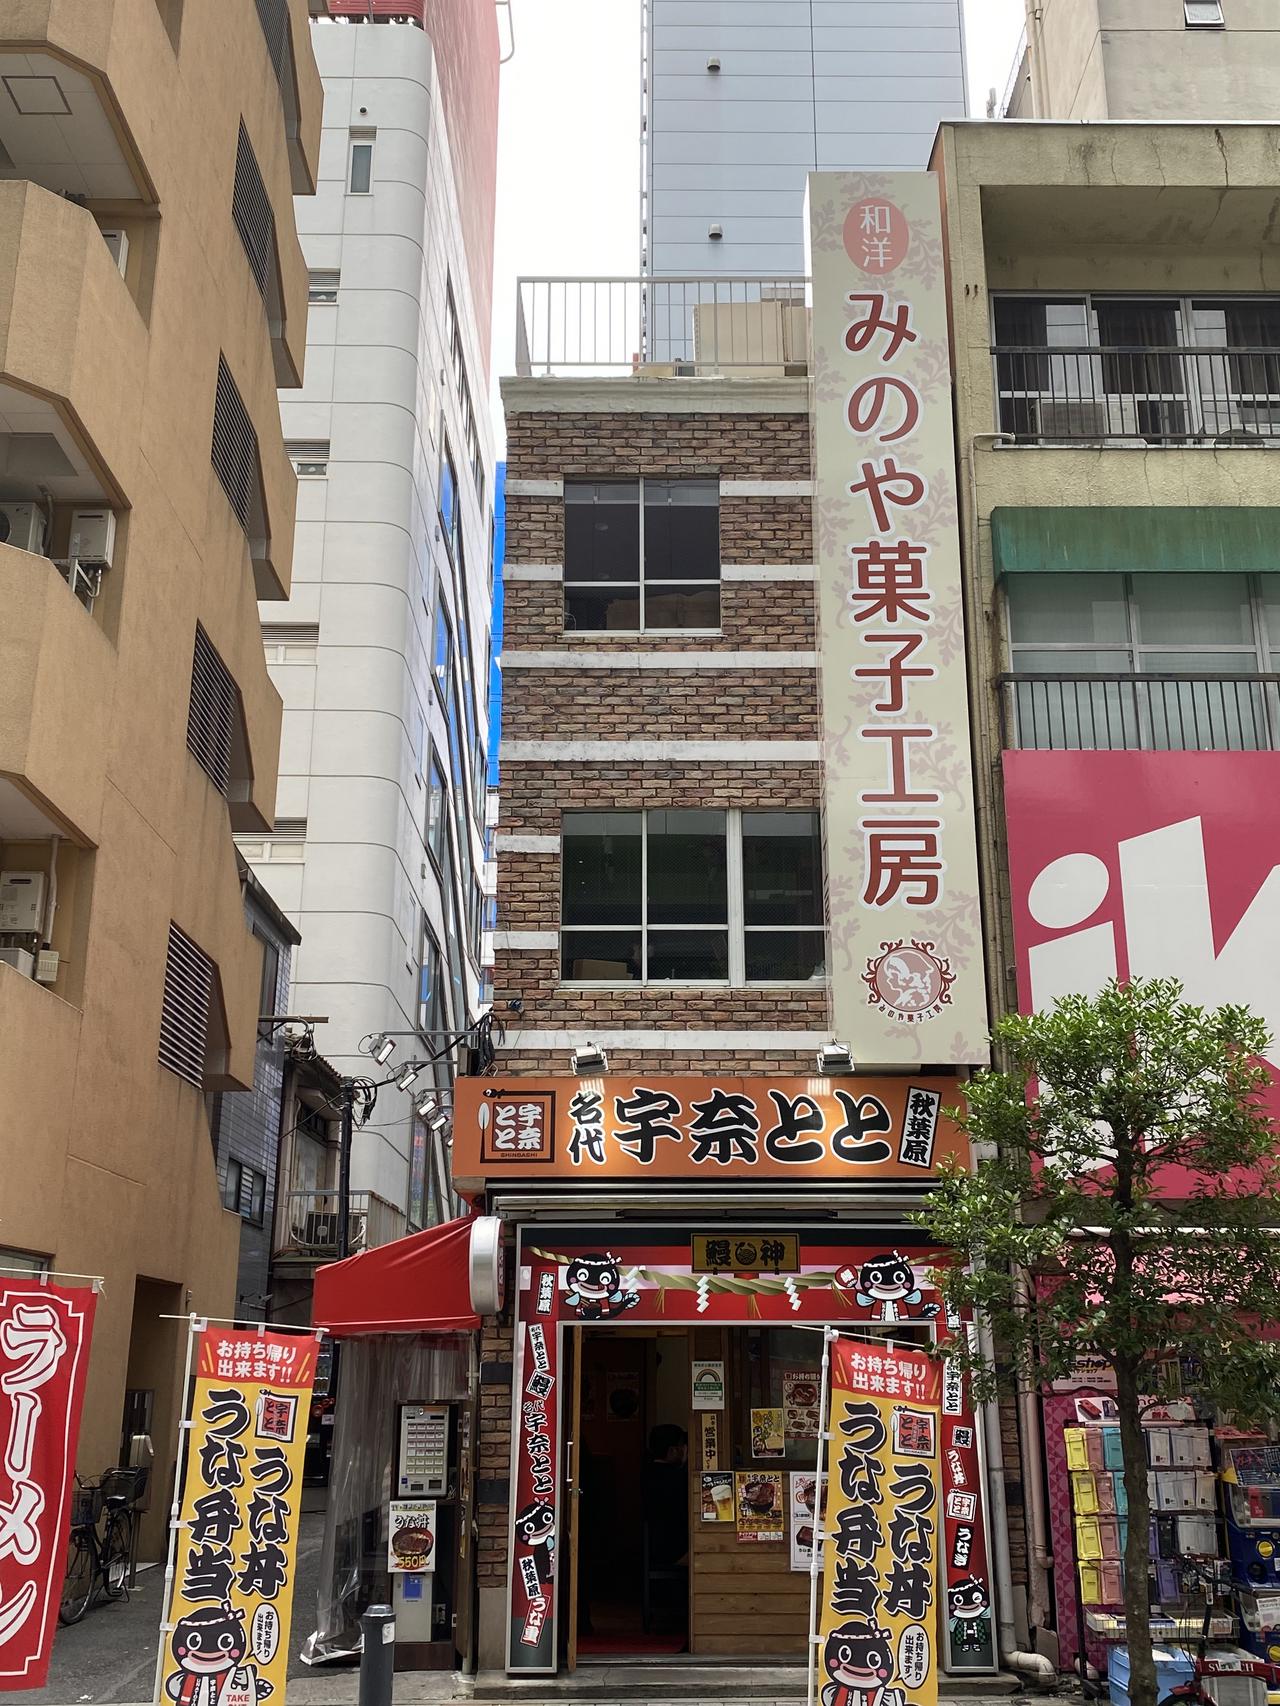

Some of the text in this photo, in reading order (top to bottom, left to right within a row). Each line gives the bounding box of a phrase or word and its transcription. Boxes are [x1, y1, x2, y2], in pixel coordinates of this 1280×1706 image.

[859, 203, 894, 268] 和洋
[843, 290, 945, 908] みのや菓子工房
[567, 1089, 607, 1166] 名代
[613, 1086, 894, 1166] 宇奈とと
[901, 1090, 936, 1165] 秋葉原
[538, 1273, 554, 1314] 秋葉原
[216, 1339, 298, 1364] お持ち帰り
[216, 1359, 292, 1384] 出来ます!!
[532, 1331, 547, 1369] 宇奈とと
[850, 1352, 928, 1382] お持ち帰り
[852, 1373, 926, 1401] 出来ます!!
[0, 1303, 67, 1647] ラーメン
[525, 1411, 554, 1495] 宇奈とと
[183, 1387, 251, 1602] うな弁当
[831, 1400, 887, 1618] うな弁当
[239, 1445, 293, 1600] うな丼
[395, 1513, 430, 1529] うな丼
[882, 1461, 936, 1620] うな丼
[397, 1554, 427, 1568] 550円
[522, 1558, 541, 1597] 秋葉原
[264, 1611, 275, 1658] お持ち帰り
[914, 1632, 925, 1682] お持ち帰り
[226, 1694, 250, 1702] TAKE
